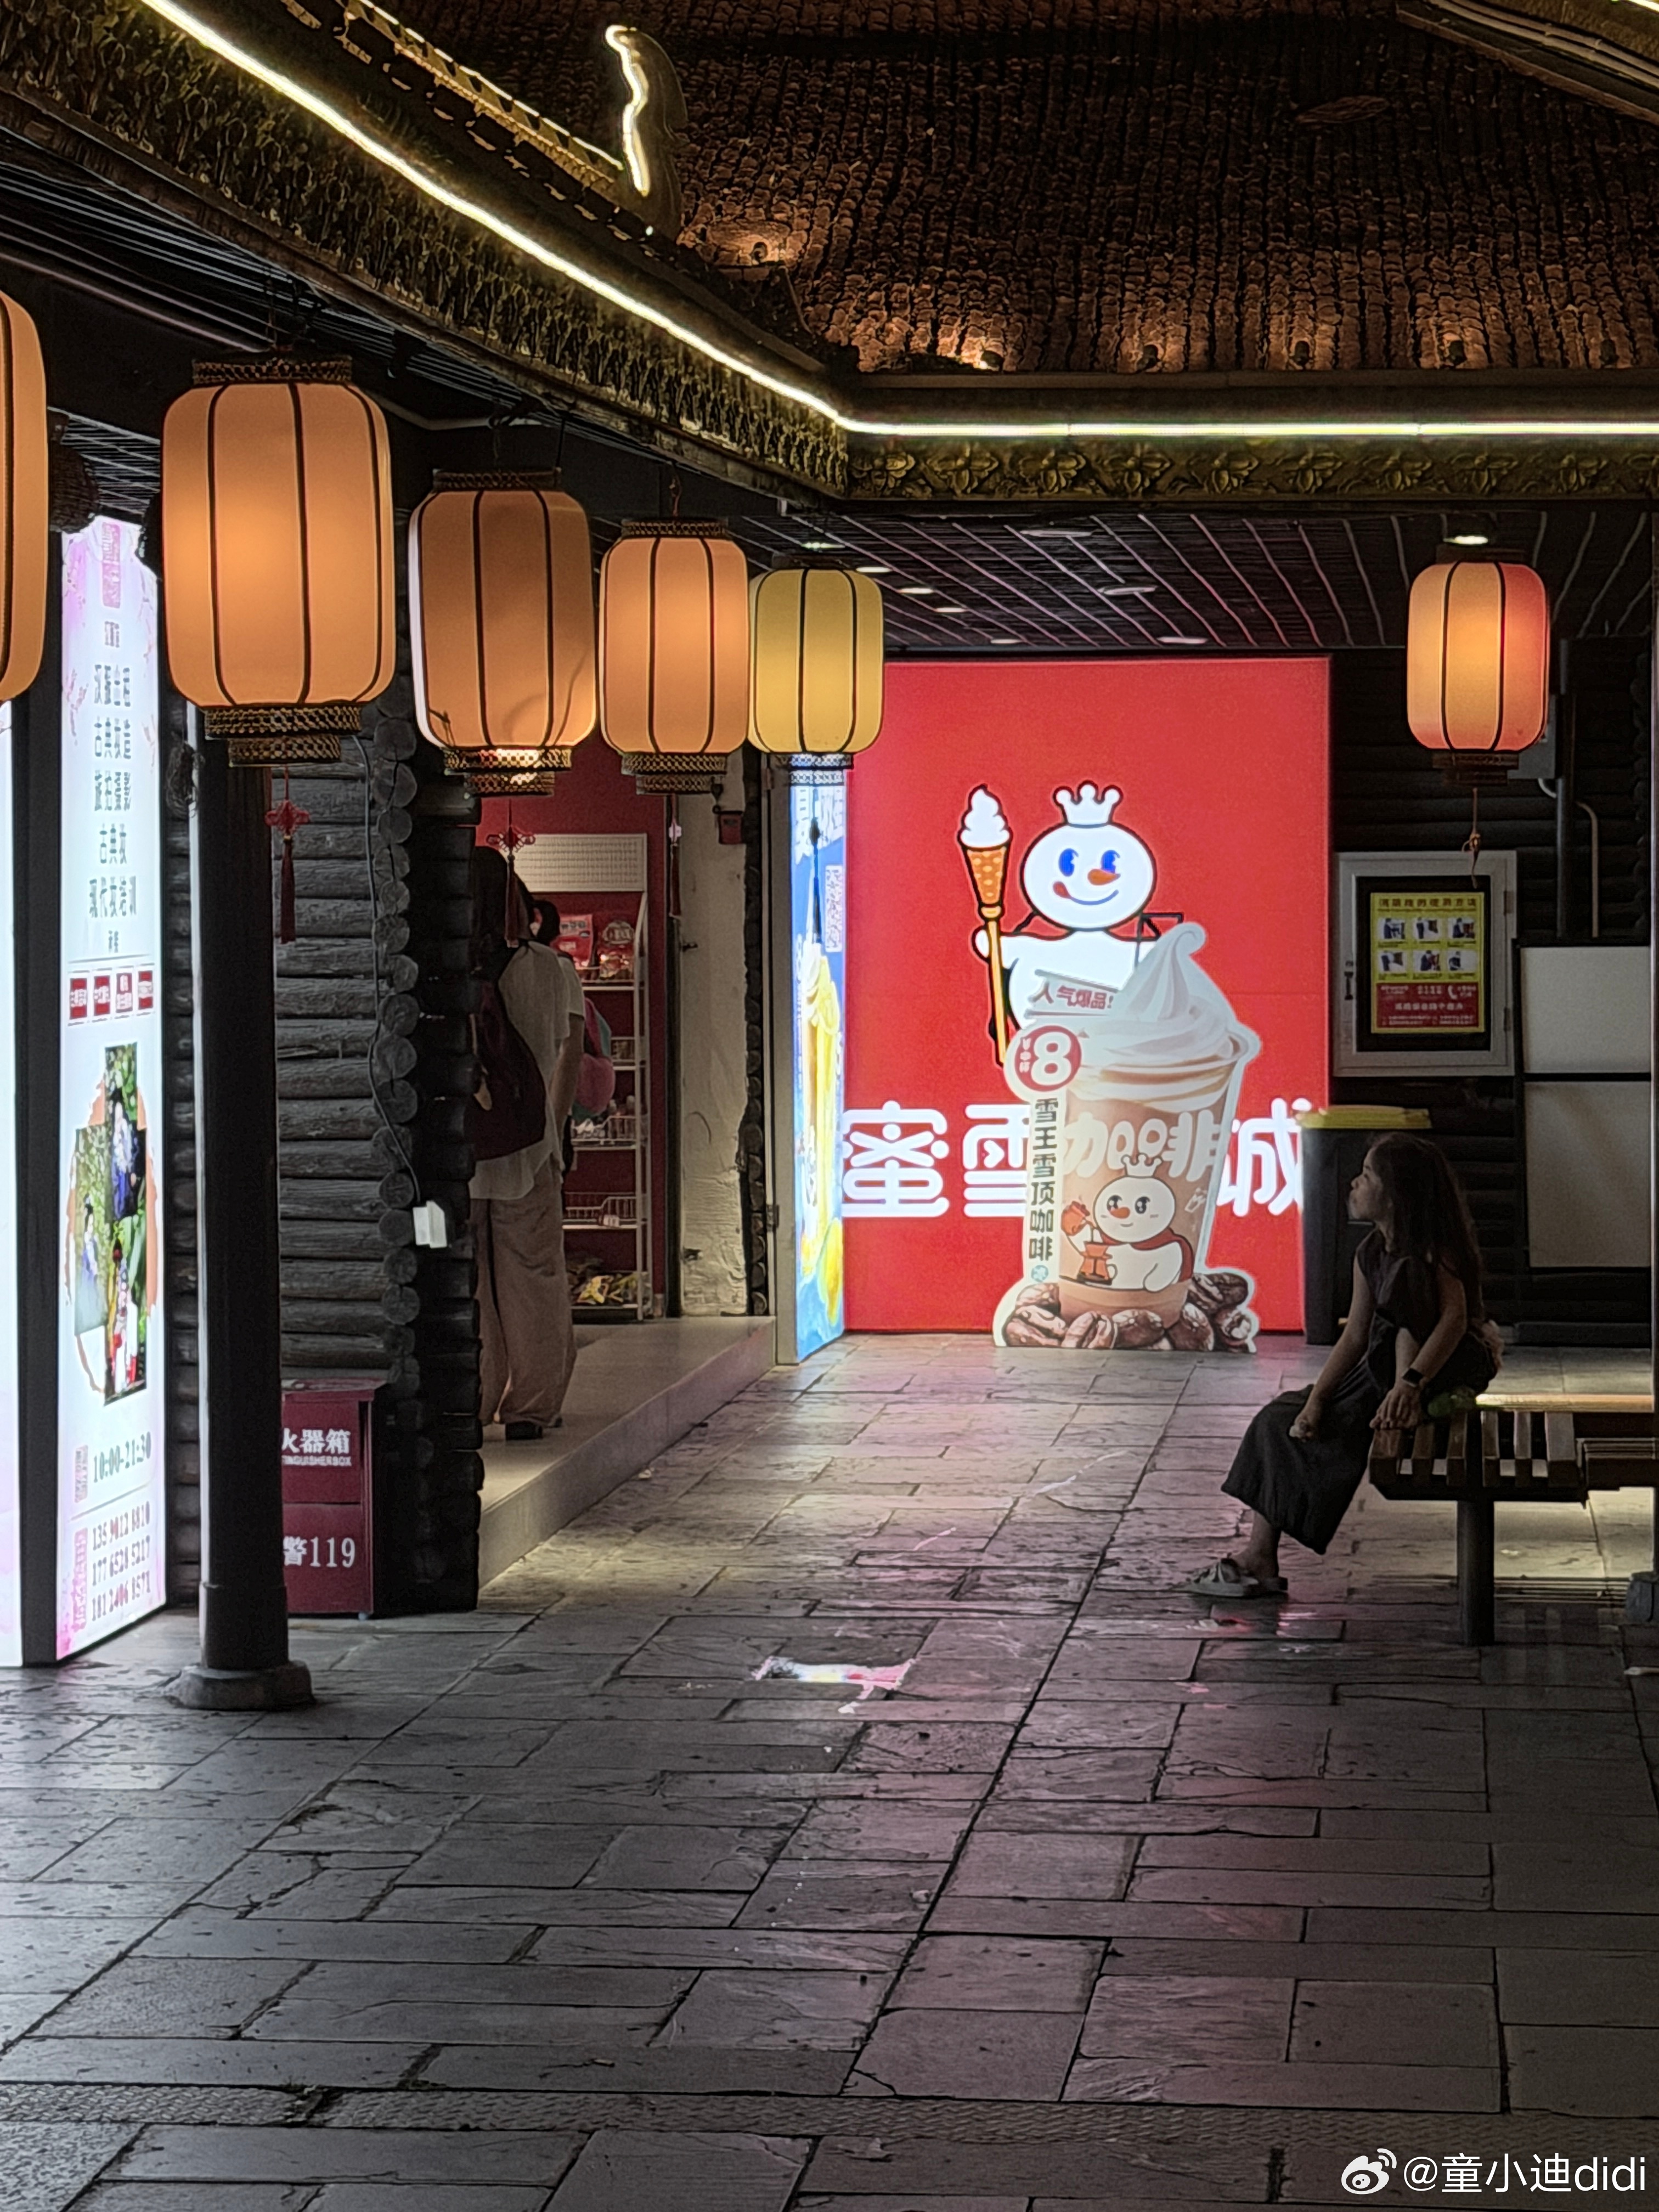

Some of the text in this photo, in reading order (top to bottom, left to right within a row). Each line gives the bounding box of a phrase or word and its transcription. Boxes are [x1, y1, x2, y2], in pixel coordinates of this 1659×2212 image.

[1030, 1031, 1072, 1086] 8
[1028, 1097, 1059, 1261] 雪王雪顶咖啡
[281, 1427, 352, 1454] 火器箱
